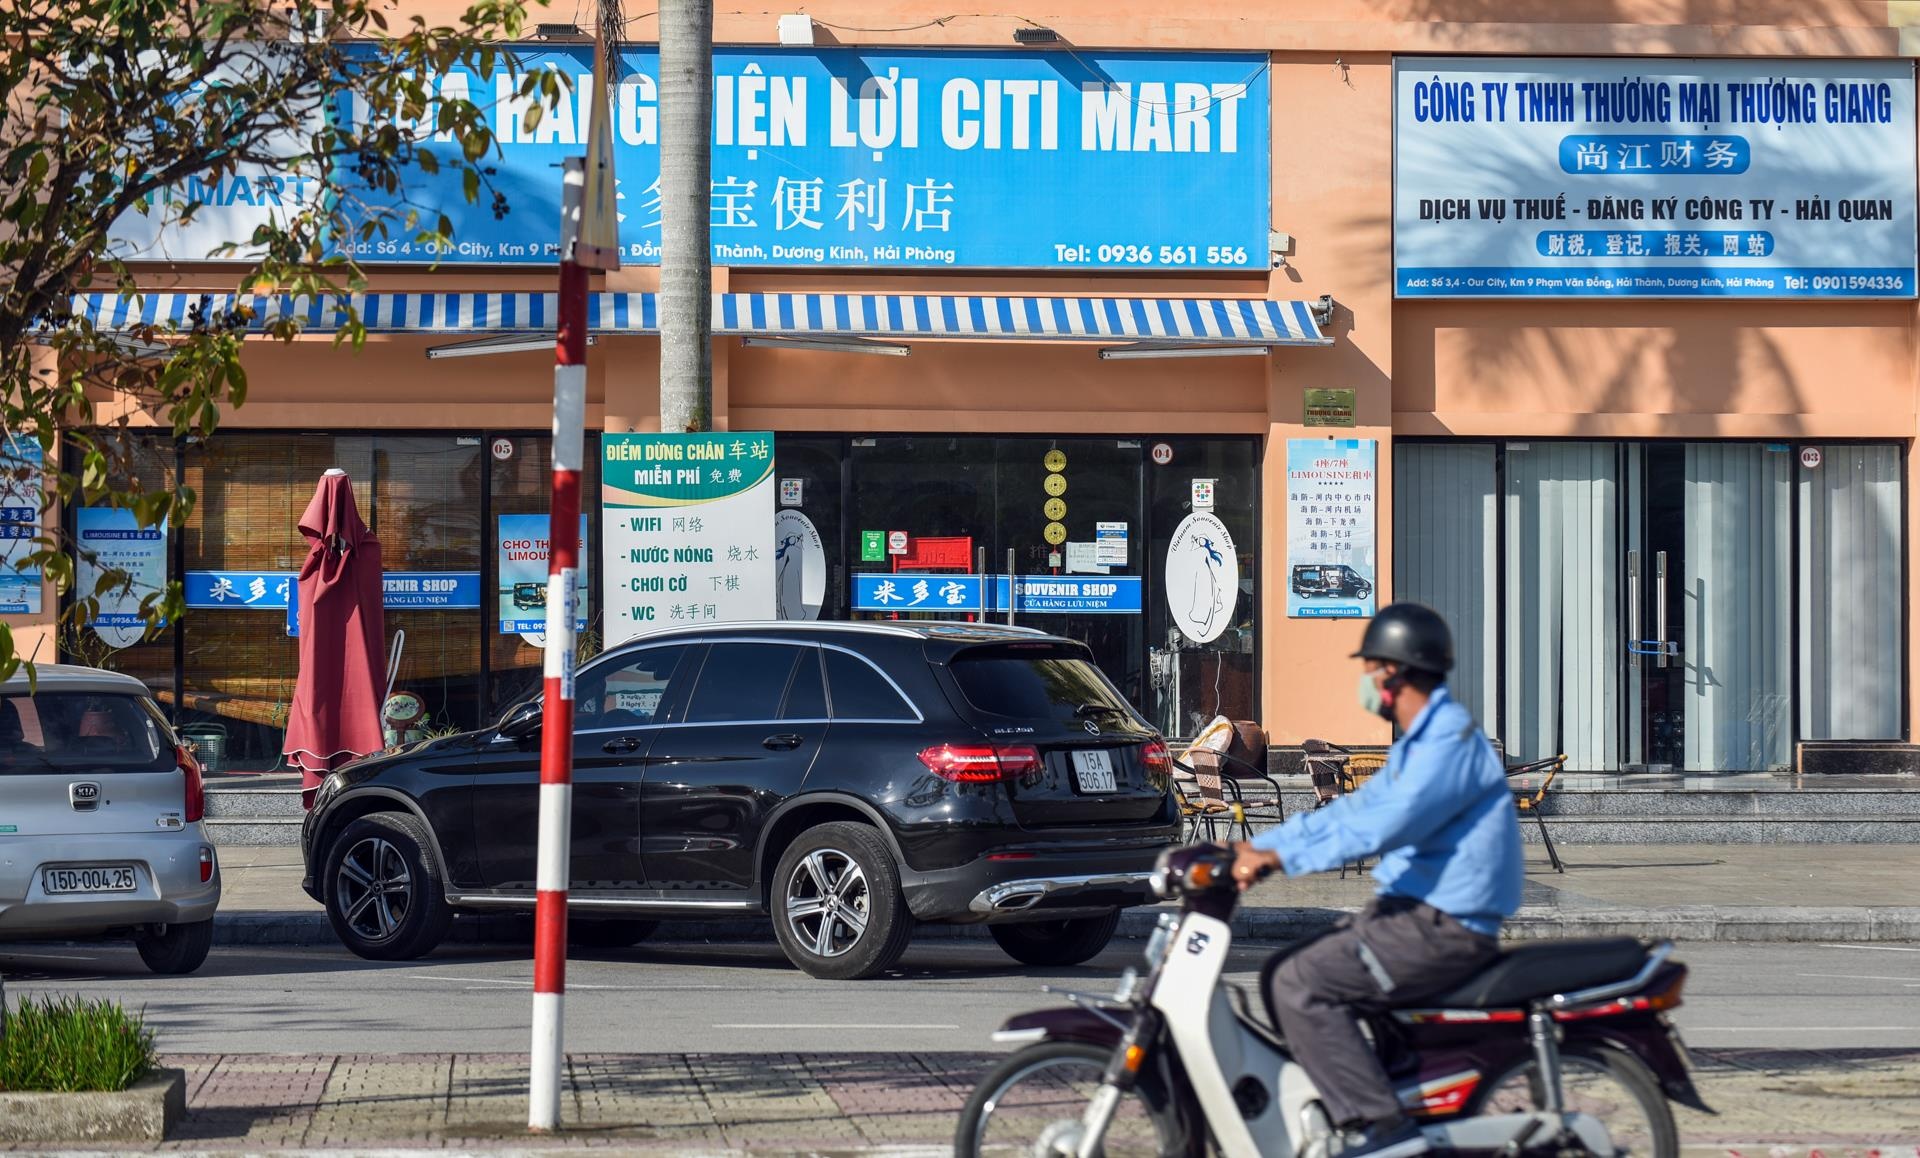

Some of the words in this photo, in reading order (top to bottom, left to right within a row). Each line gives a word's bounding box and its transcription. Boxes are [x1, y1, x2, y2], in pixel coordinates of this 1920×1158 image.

[712, 62, 807, 160] IỆN
[830, 66, 918, 162] LỢI
[941, 76, 1059, 151] CITI
[1082, 80, 1247, 154] MART
[1414, 75, 1475, 123] CÔNG
[1482, 82, 1508, 122] TY
[1515, 82, 1574, 122] TNHH
[1582, 76, 1671, 123] THƯƠNG
[1679, 82, 1721, 131] MẠI
[1728, 77, 1816, 131] THƯỢNG
[1825, 82, 1892, 124] GIANG
[1577, 140, 1739, 170] 尚江财务
[188, 175, 314, 207] MART
[1420, 199, 1471, 224] DỊCH
[1478, 199, 1506, 224] VỤ
[1513, 192, 1567, 220] THUẾ
[1587, 195, 1644, 221] ĐĂNG
[1652, 196, 1679, 221] KÝ
[1685, 196, 1743, 221] CÔNG
[1750, 199, 1775, 220] TY
[1796, 194, 1831, 221] HẢI
[1838, 199, 1893, 222] QUAN
[333, 240, 372, 255] Add:
[377, 238, 397, 255] Số
[400, 244, 411, 255] 4
[458, 242, 493, 258] City,
[499, 244, 524, 256] Km
[529, 244, 540, 256] 9
[715, 244, 768, 260] Thành,
[772, 244, 825, 261] Dương
[829, 246, 869, 262] Kinh,
[873, 244, 900, 260] Hải
[905, 246, 956, 263] Phòng
[1055, 244, 1091, 262] Tel:
[1098, 245, 1153, 263] 0936
[1159, 246, 1196, 264] 561
[1206, 247, 1248, 264] 556
[1407, 278, 1430, 288] Add:
[1431, 276, 1444, 288] Số
[1445, 279, 1460, 289] 3,4
[1468, 278, 1485, 288] Our
[1487, 277, 1508, 290] City,
[1510, 278, 1526, 287] Km
[1528, 278, 1534, 288] 9
[1536, 278, 1564, 290] Phạm
[1565, 277, 1584, 288] Văn
[1616, 275, 1633, 288] Hải
[1635, 276, 1665, 289] Thành,
[1668, 277, 1699, 290] Dương
[1701, 278, 1725, 290] Kinh,
[1726, 276, 1743, 288] Hải
[1744, 277, 1775, 290] Phòng
[1784, 275, 1809, 290] Tel:
[1812, 275, 1904, 291] 0901594336
[494, 444, 511, 456] 05
[606, 438, 642, 461] ĐIỂM
[646, 441, 683, 461] DỪNG
[687, 440, 724, 461] CHÂN
[729, 439, 770, 461] 车站
[1154, 448, 1171, 459] 04
[1802, 452, 1819, 462] 03
[634, 464, 672, 486] MIỄN
[676, 466, 700, 485] PHÍ
[708, 467, 743, 485] 免费
[631, 517, 662, 532] WIFI
[672, 516, 704, 533] 网络
[502, 540, 531, 549] CHO
[630, 546, 669, 563] NƯỚC
[674, 547, 713, 563] NÓNG
[726, 544, 760, 562] 烧水
[383, 579, 419, 592] VENIR
[422, 579, 458, 592] SHOP
[631, 575, 664, 592] CHƠI
[668, 573, 688, 592] CỜ
[708, 574, 741, 592] 下棋
[873, 578, 967, 606] 米多宝
[1015, 583, 1079, 596] SOUVENIR
[1082, 583, 1117, 596] SHOP
[631, 606, 655, 621] WC
[670, 603, 717, 621] 洗手间
[1042, 598, 1066, 608] HÀNG
[1067, 600, 1084, 608] LƯU
[1086, 600, 1107, 609] NIỆM
[1082, 752, 1104, 771] 15A
[1078, 771, 1113, 790] 506.17
[77, 788, 96, 797] KIA
[50, 869, 133, 890] 15D-004.25
